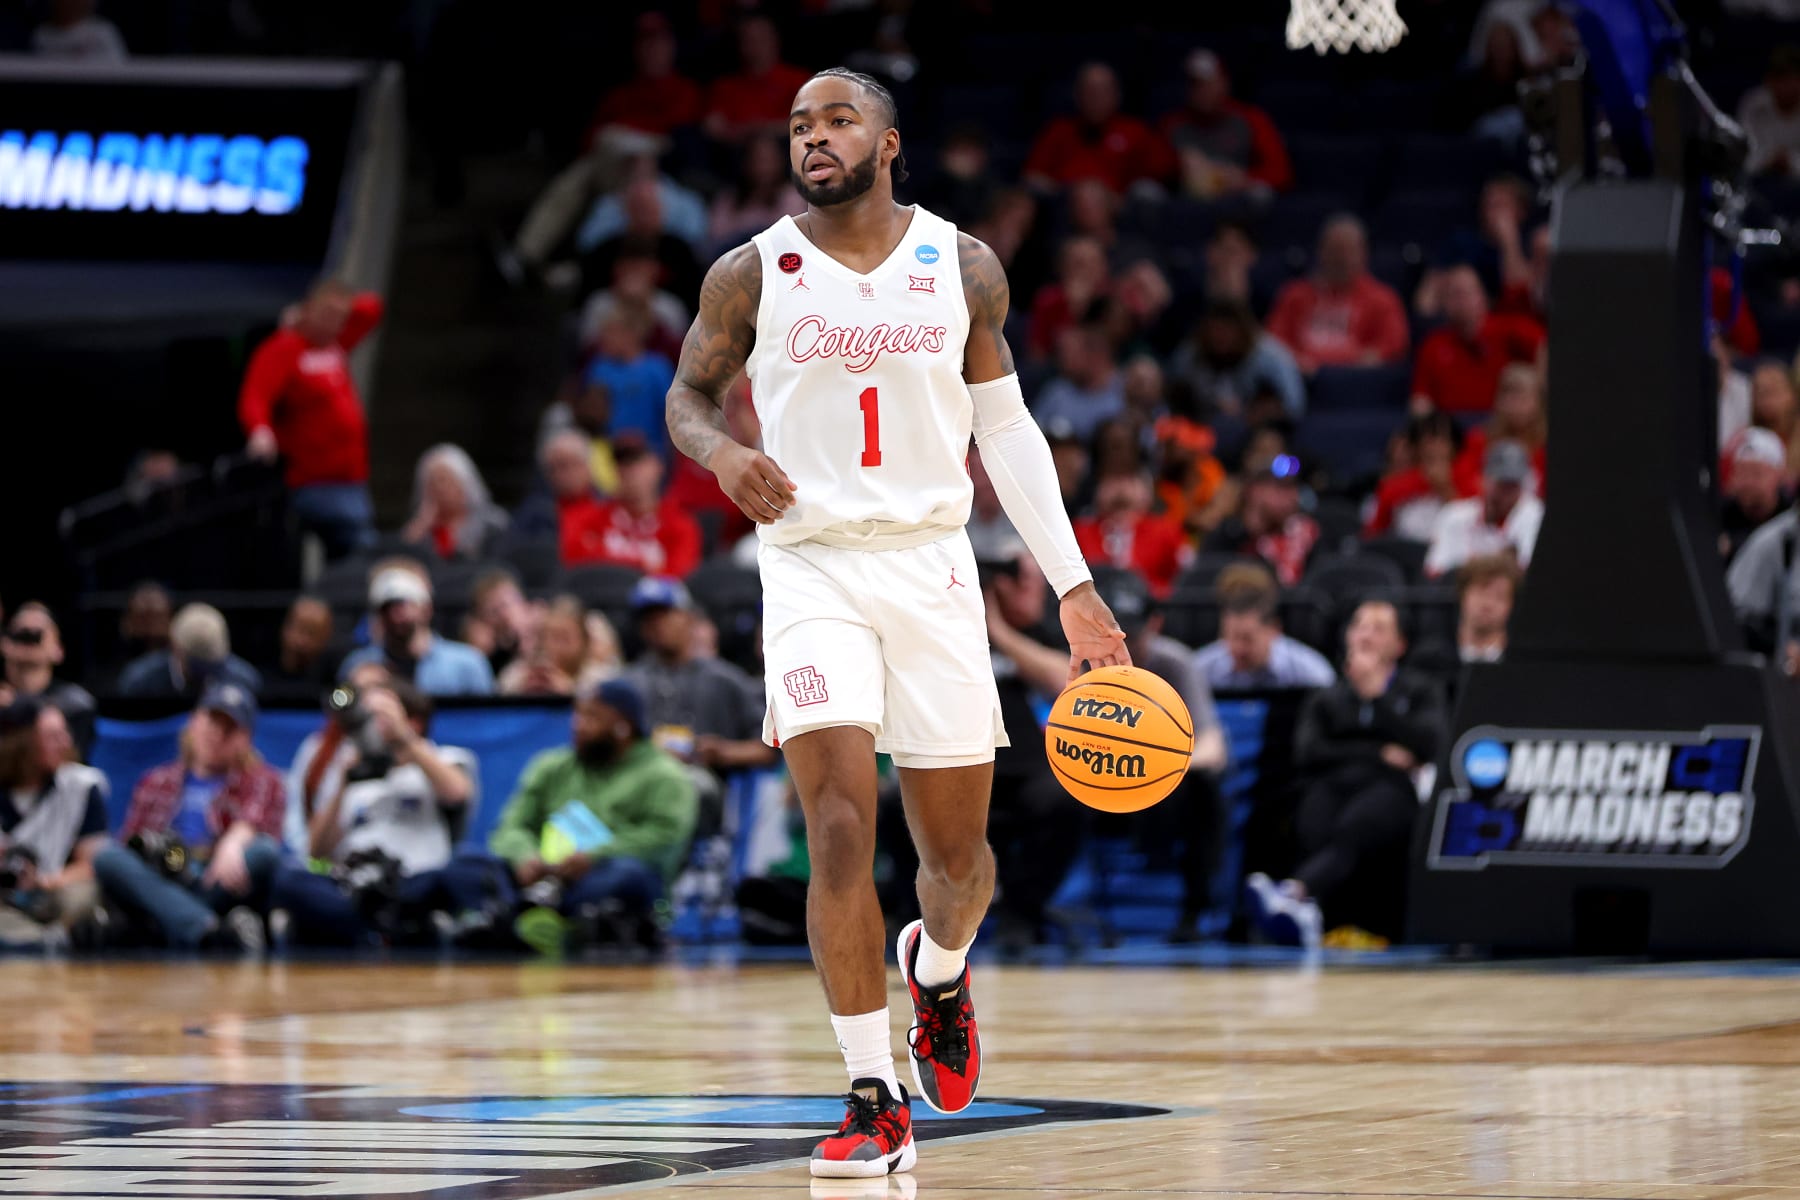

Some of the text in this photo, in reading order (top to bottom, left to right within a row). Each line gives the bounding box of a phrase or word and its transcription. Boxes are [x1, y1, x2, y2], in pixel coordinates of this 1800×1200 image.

[0, 130, 309, 214] MADNESS
[782, 256, 799, 270] 32
[787, 315, 947, 373] Cougars
[859, 387, 881, 467] 1
[784, 665, 828, 707] UH
[1072, 698, 1143, 728] NCAA
[1056, 736, 1146, 778] Wilson
[1506, 738, 1671, 792] MARCH
[1522, 790, 1744, 845] MADNESS
